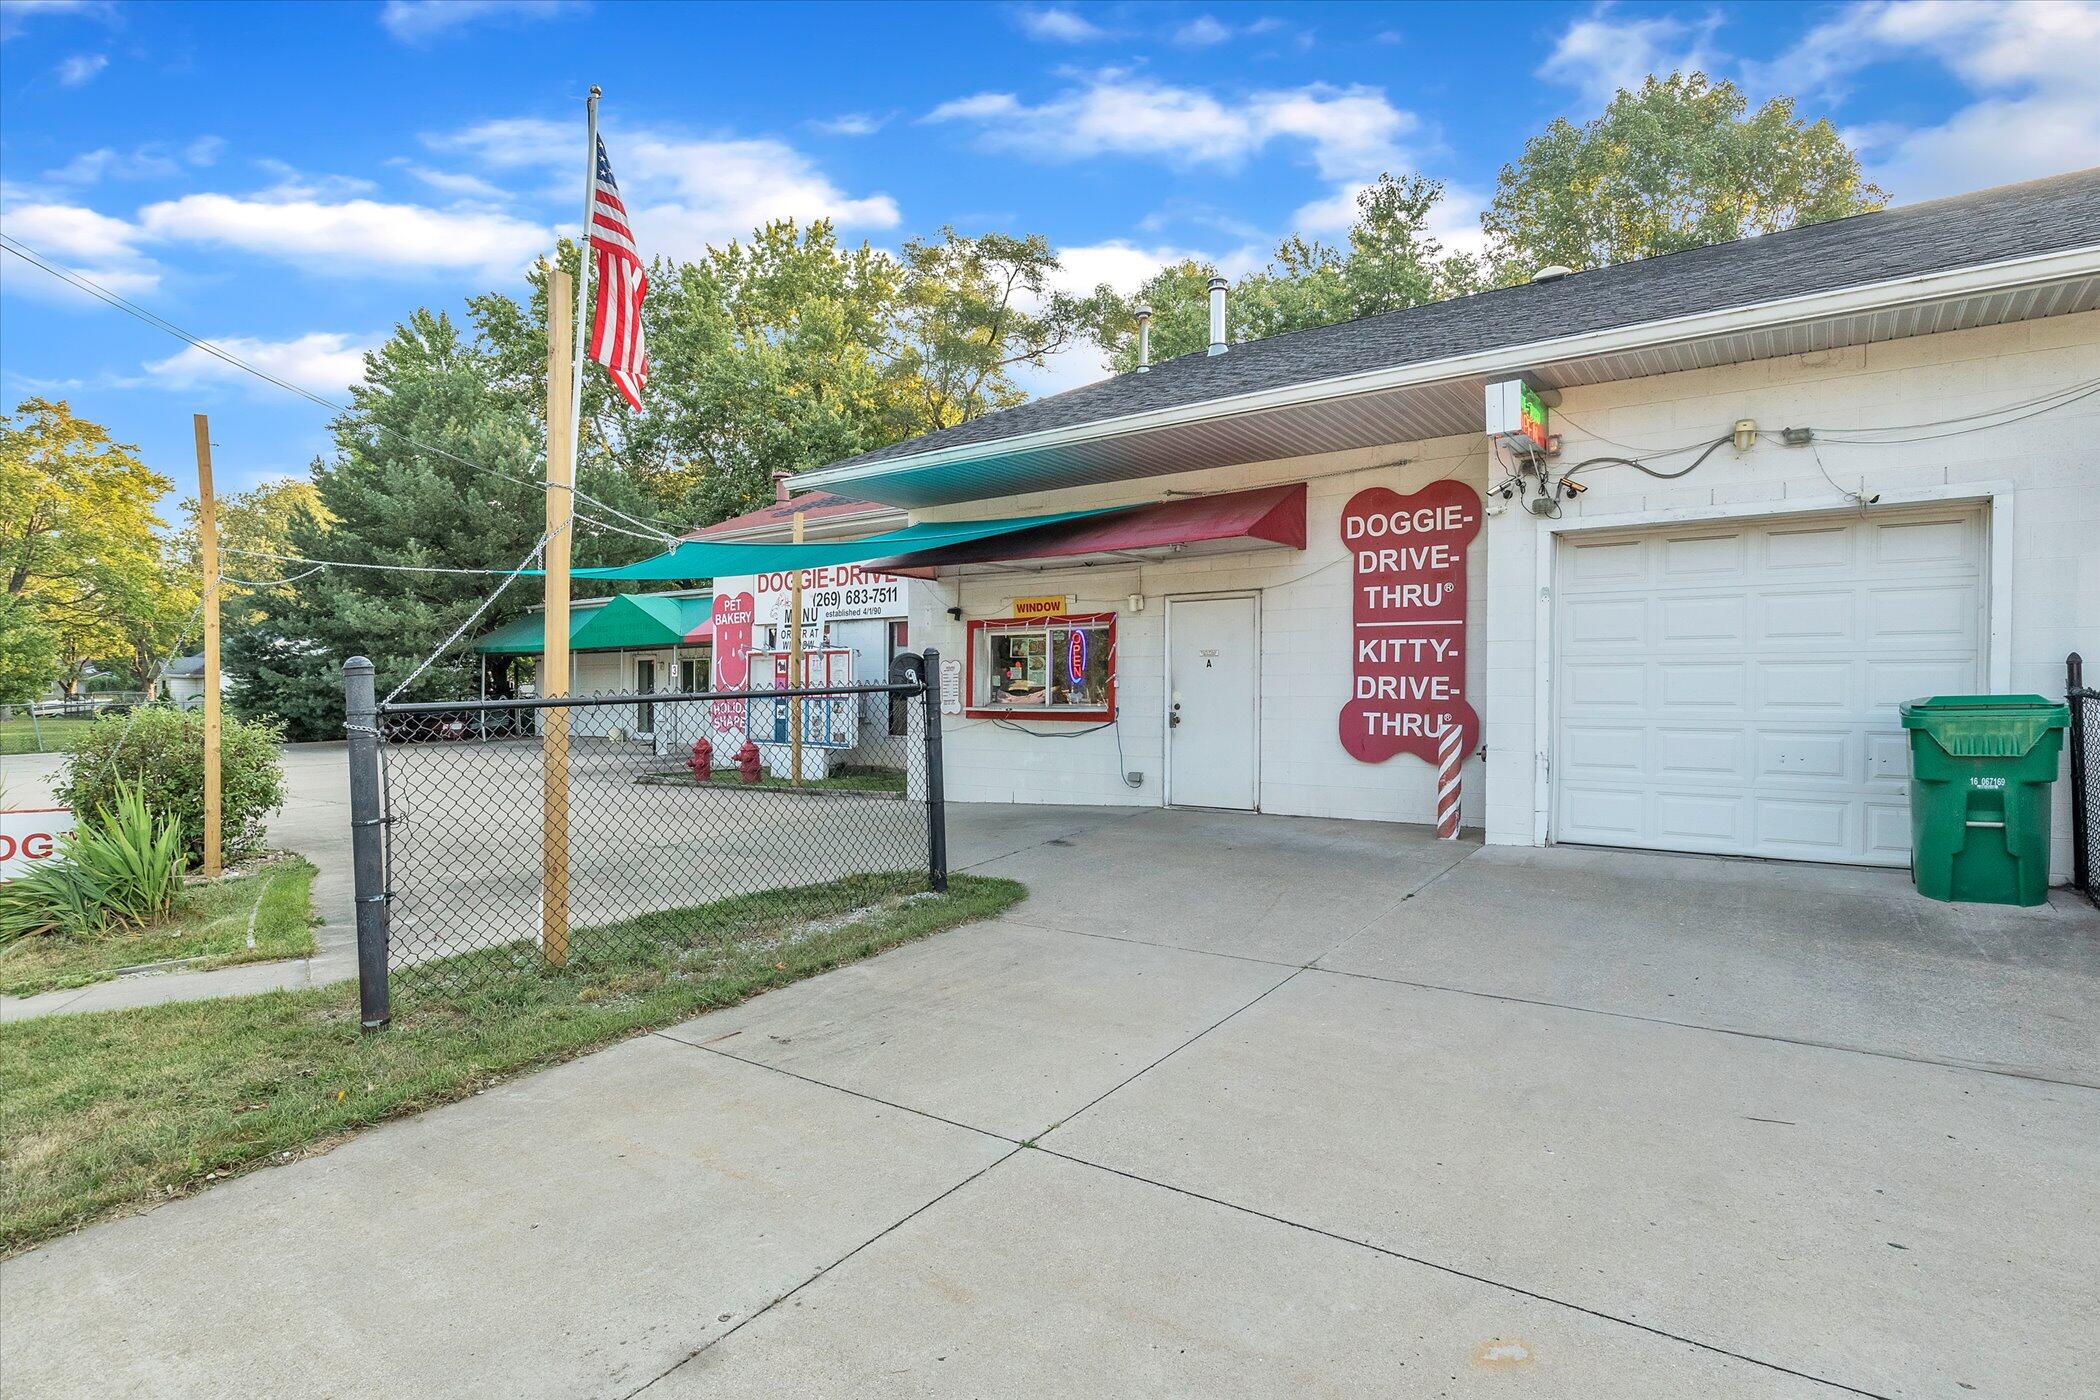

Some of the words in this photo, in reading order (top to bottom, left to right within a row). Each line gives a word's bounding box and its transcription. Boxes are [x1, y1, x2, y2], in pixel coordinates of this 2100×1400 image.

[1346, 505, 1473, 539] DOGGIE-
[1358, 545, 1460, 574] DRIVE-
[724, 599, 742, 611] PET
[812, 591, 841, 609] (269)
[846, 586, 898, 606] 683-7511
[825, 607, 861, 618] established
[862, 606, 882, 616] 4/1/90
[1016, 601, 1060, 613] WINDOW
[715, 611, 752, 626] BAKERY
[784, 607, 818, 623] MNU
[780, 629, 807, 639] ORR
[809, 628, 819, 638] AT
[782, 640, 815, 650] WIOW
[1358, 638, 1459, 663] KITTY-
[1072, 632, 1082, 678] OPEN
[672, 665, 677, 675] 3
[1206, 659, 1212, 668] A
[1356, 676, 1460, 701] DRIVE-
